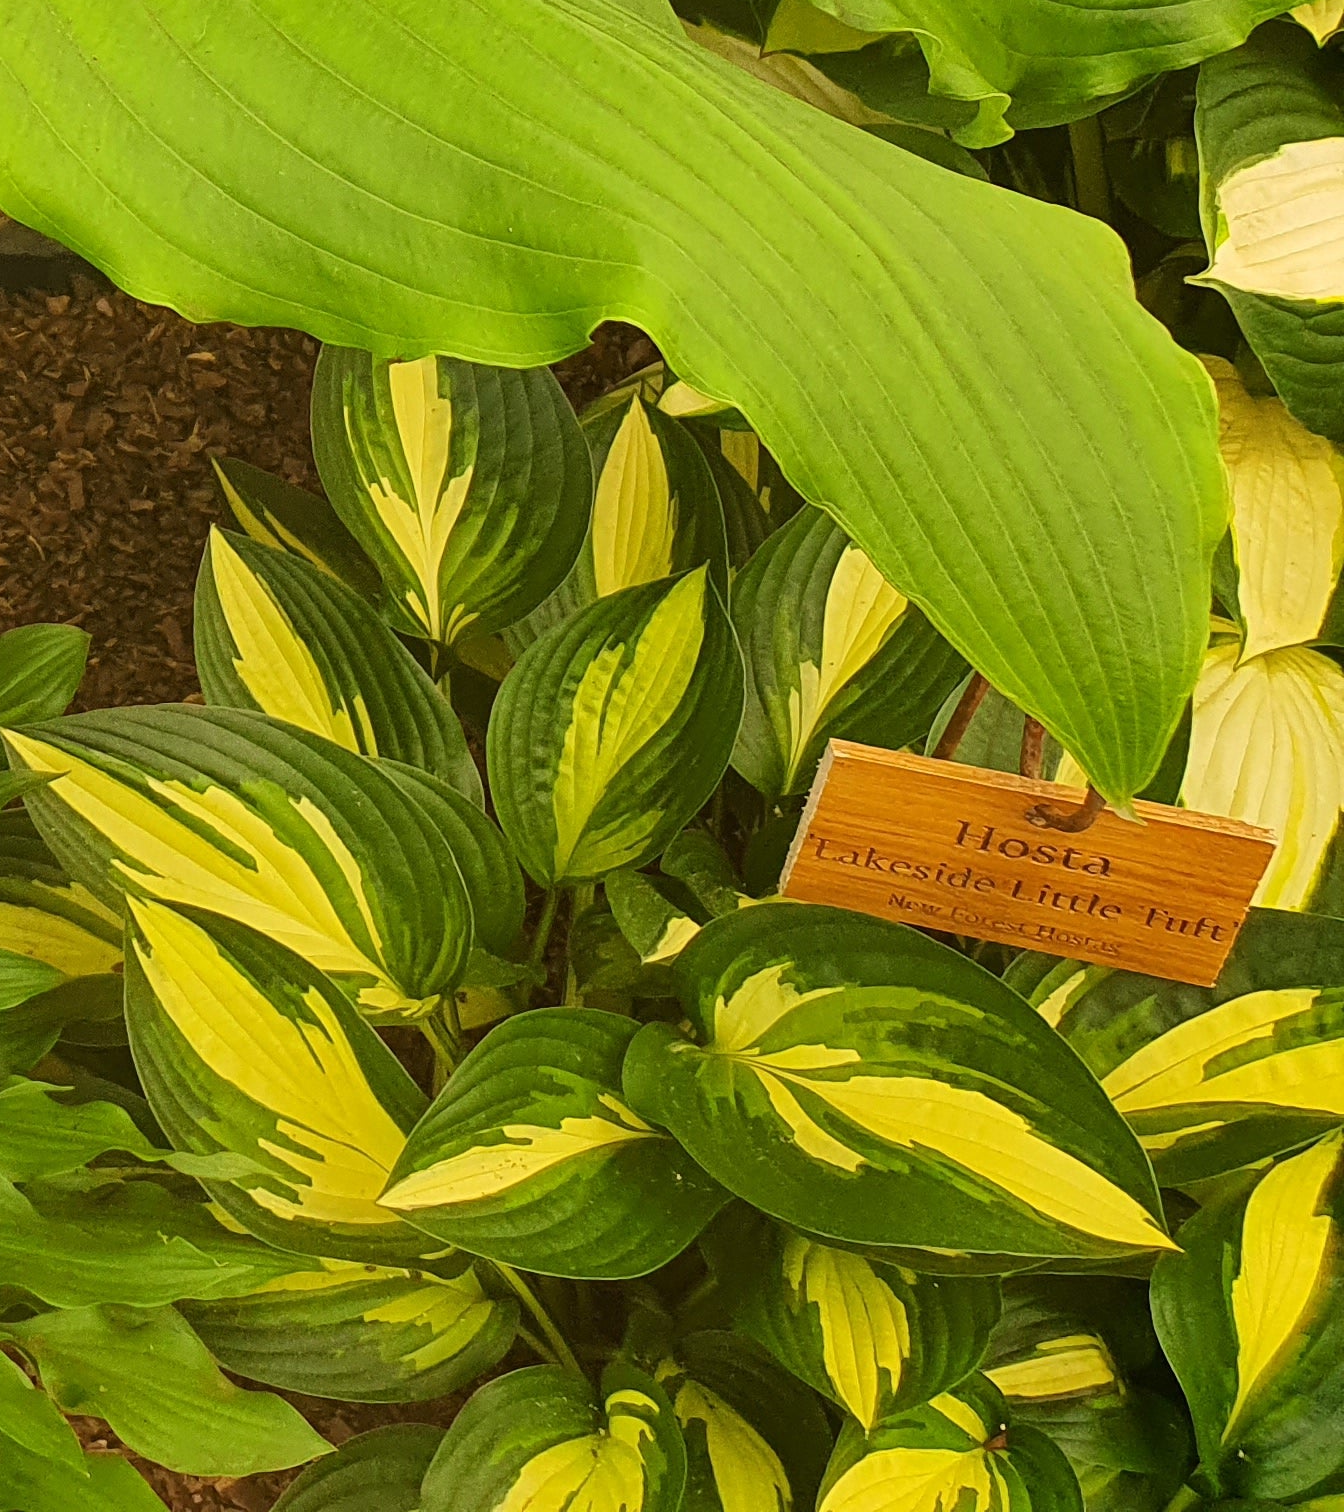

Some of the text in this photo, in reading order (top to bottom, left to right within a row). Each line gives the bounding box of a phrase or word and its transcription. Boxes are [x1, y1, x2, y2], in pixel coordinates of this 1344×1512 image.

[809, 833, 997, 894] 'Lakeside
[1011, 879, 1123, 920] Little
[955, 819, 1113, 879] Hosta
[887, 892, 943, 916] New
[950, 905, 1025, 935] Forest
